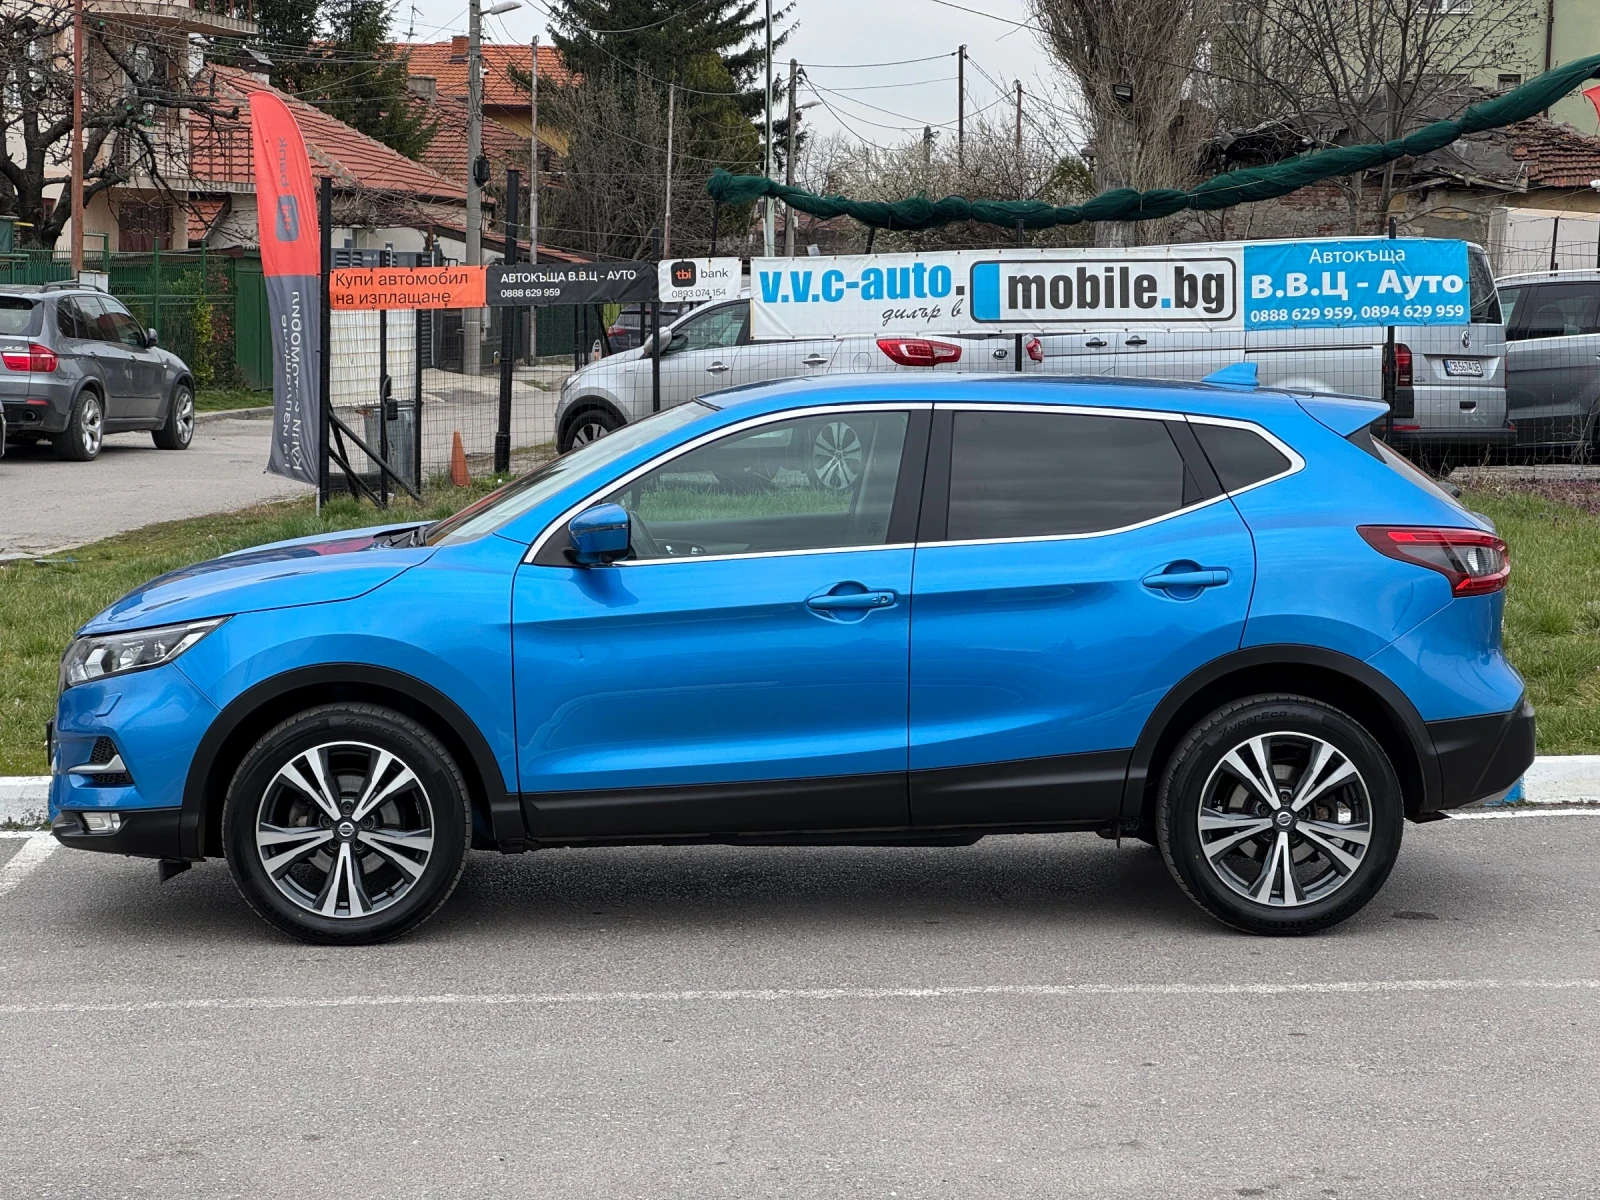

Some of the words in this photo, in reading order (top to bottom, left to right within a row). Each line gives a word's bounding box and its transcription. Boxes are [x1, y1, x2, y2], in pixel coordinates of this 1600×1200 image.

[1309, 248, 1406, 265] Автокъща
[335, 272, 374, 289] Купи
[378, 271, 469, 287] автомобил
[501, 272, 566, 284] АВТОКЪЩА
[568, 269, 599, 283] В.В.Ц
[606, 269, 637, 281] АУТО
[675, 267, 692, 280] tbi
[700, 267, 729, 279] bank
[501, 288, 524, 298] 0888
[525, 288, 542, 297] 629
[543, 287, 560, 296] 959
[671, 289, 694, 298] 0893
[695, 288, 711, 297] 074
[712, 288, 727, 297] 154
[1008, 265, 1225, 314] mobile.bg
[1251, 271, 1348, 300] В.В.Ц
[1377, 269, 1463, 300] Ауто
[335, 294, 355, 305] на
[359, 291, 451, 306] изплащане
[882, 304, 942, 326] дилър
[1251, 309, 1288, 322] 0888
[1291, 308, 1321, 321] 629
[1324, 306, 1357, 321] 959,
[1361, 305, 1400, 318] 0894
[1403, 305, 1433, 318] 629
[1435, 304, 1464, 317] 959
